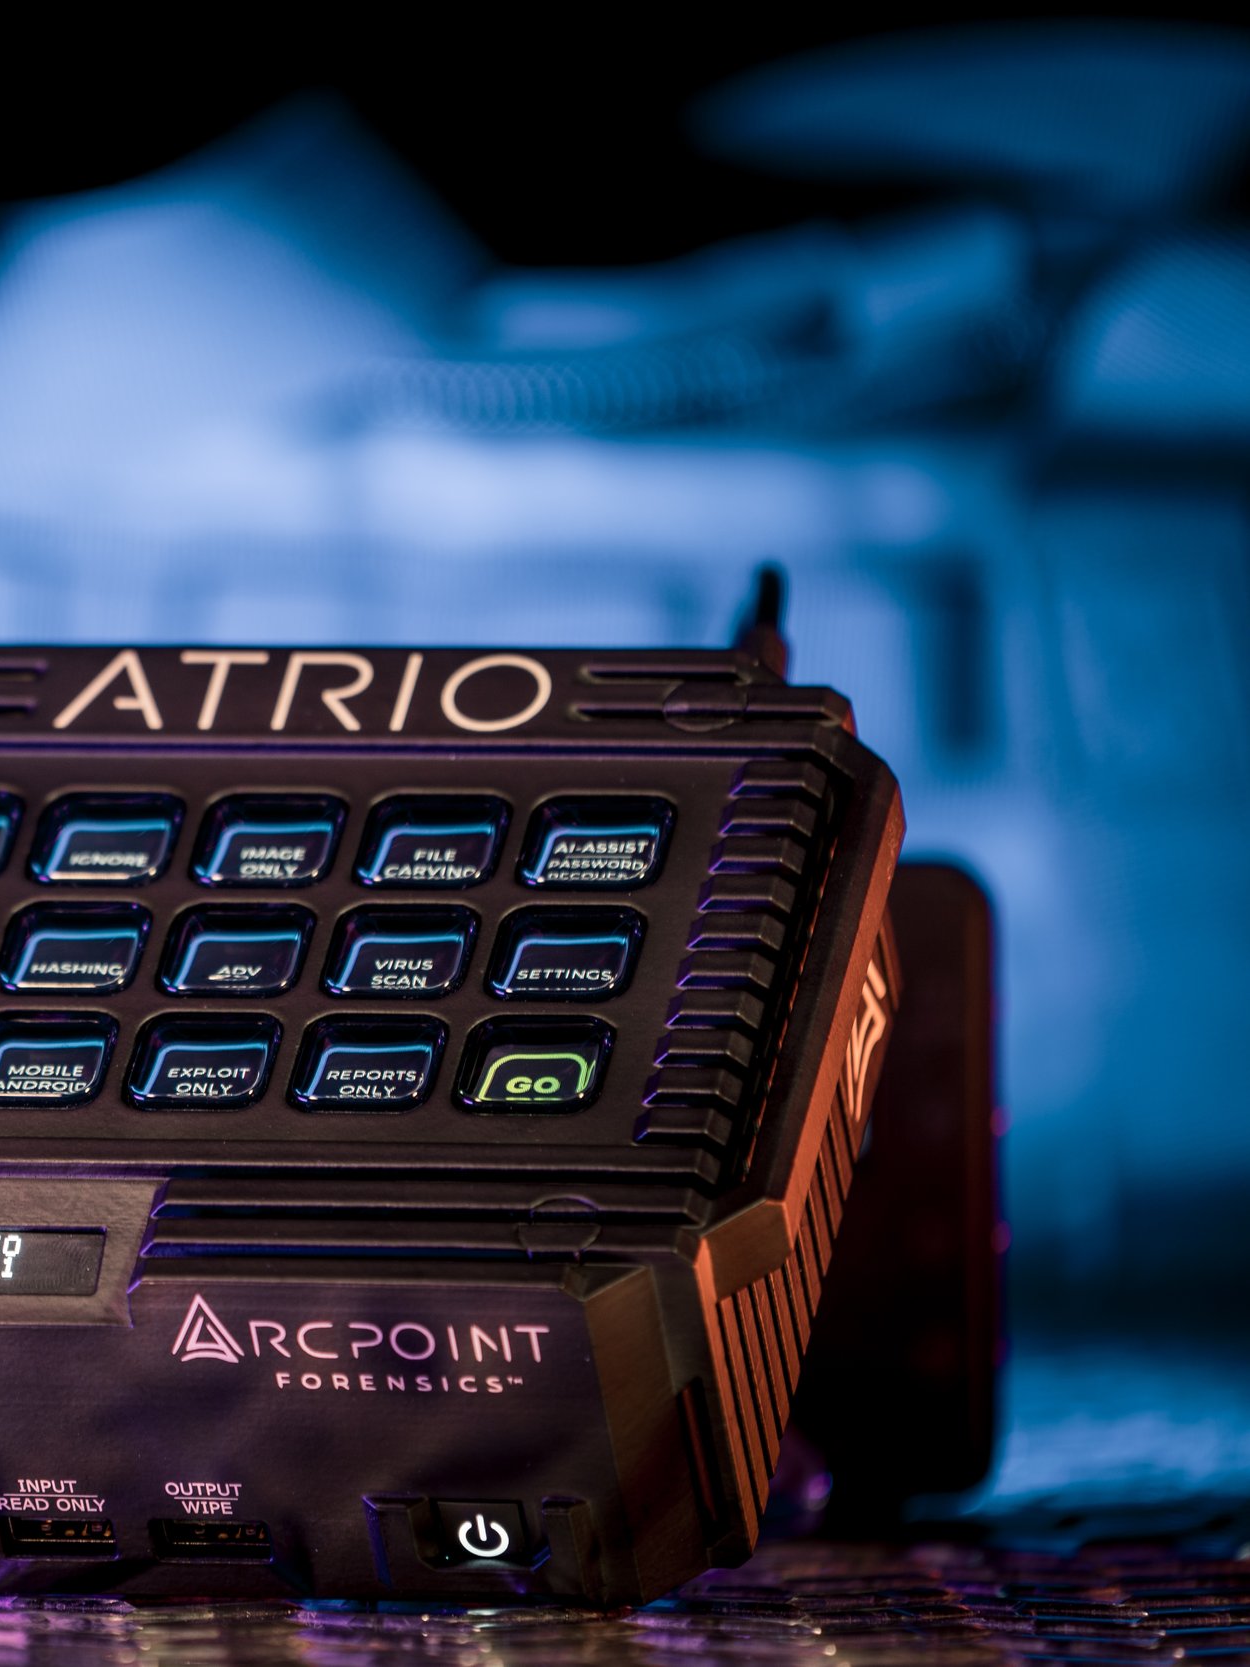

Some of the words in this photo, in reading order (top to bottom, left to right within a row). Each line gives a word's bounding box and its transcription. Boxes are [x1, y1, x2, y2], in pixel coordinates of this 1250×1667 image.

[52, 649, 552, 732] ATRIO
[241, 846, 306, 861] IMAGE
[554, 840, 648, 854] AI-ASSIST
[70, 853, 148, 868] IGNORE
[414, 848, 457, 862] FILE
[240, 863, 299, 877] ONLY
[548, 858, 645, 870] PASSWORD
[32, 963, 123, 976] HASHING
[218, 965, 261, 977] ADV
[375, 959, 433, 971] VIRUS
[371, 975, 427, 988] SCAN
[516, 969, 613, 981] SETTINGS
[9, 1065, 83, 1077] MOBILE
[168, 1068, 250, 1079] EXPLOIT
[327, 1070, 416, 1082] REPORTS
[176, 1083, 232, 1095] ONLY
[340, 1085, 395, 1097] ONLY
[506, 1076, 560, 1095] GO
[18, 1479, 76, 1494] INPUT
[165, 1482, 242, 1497] OUTPUT
[56, 1498, 105, 1512] ONLY
[182, 1500, 233, 1515] WIPE
